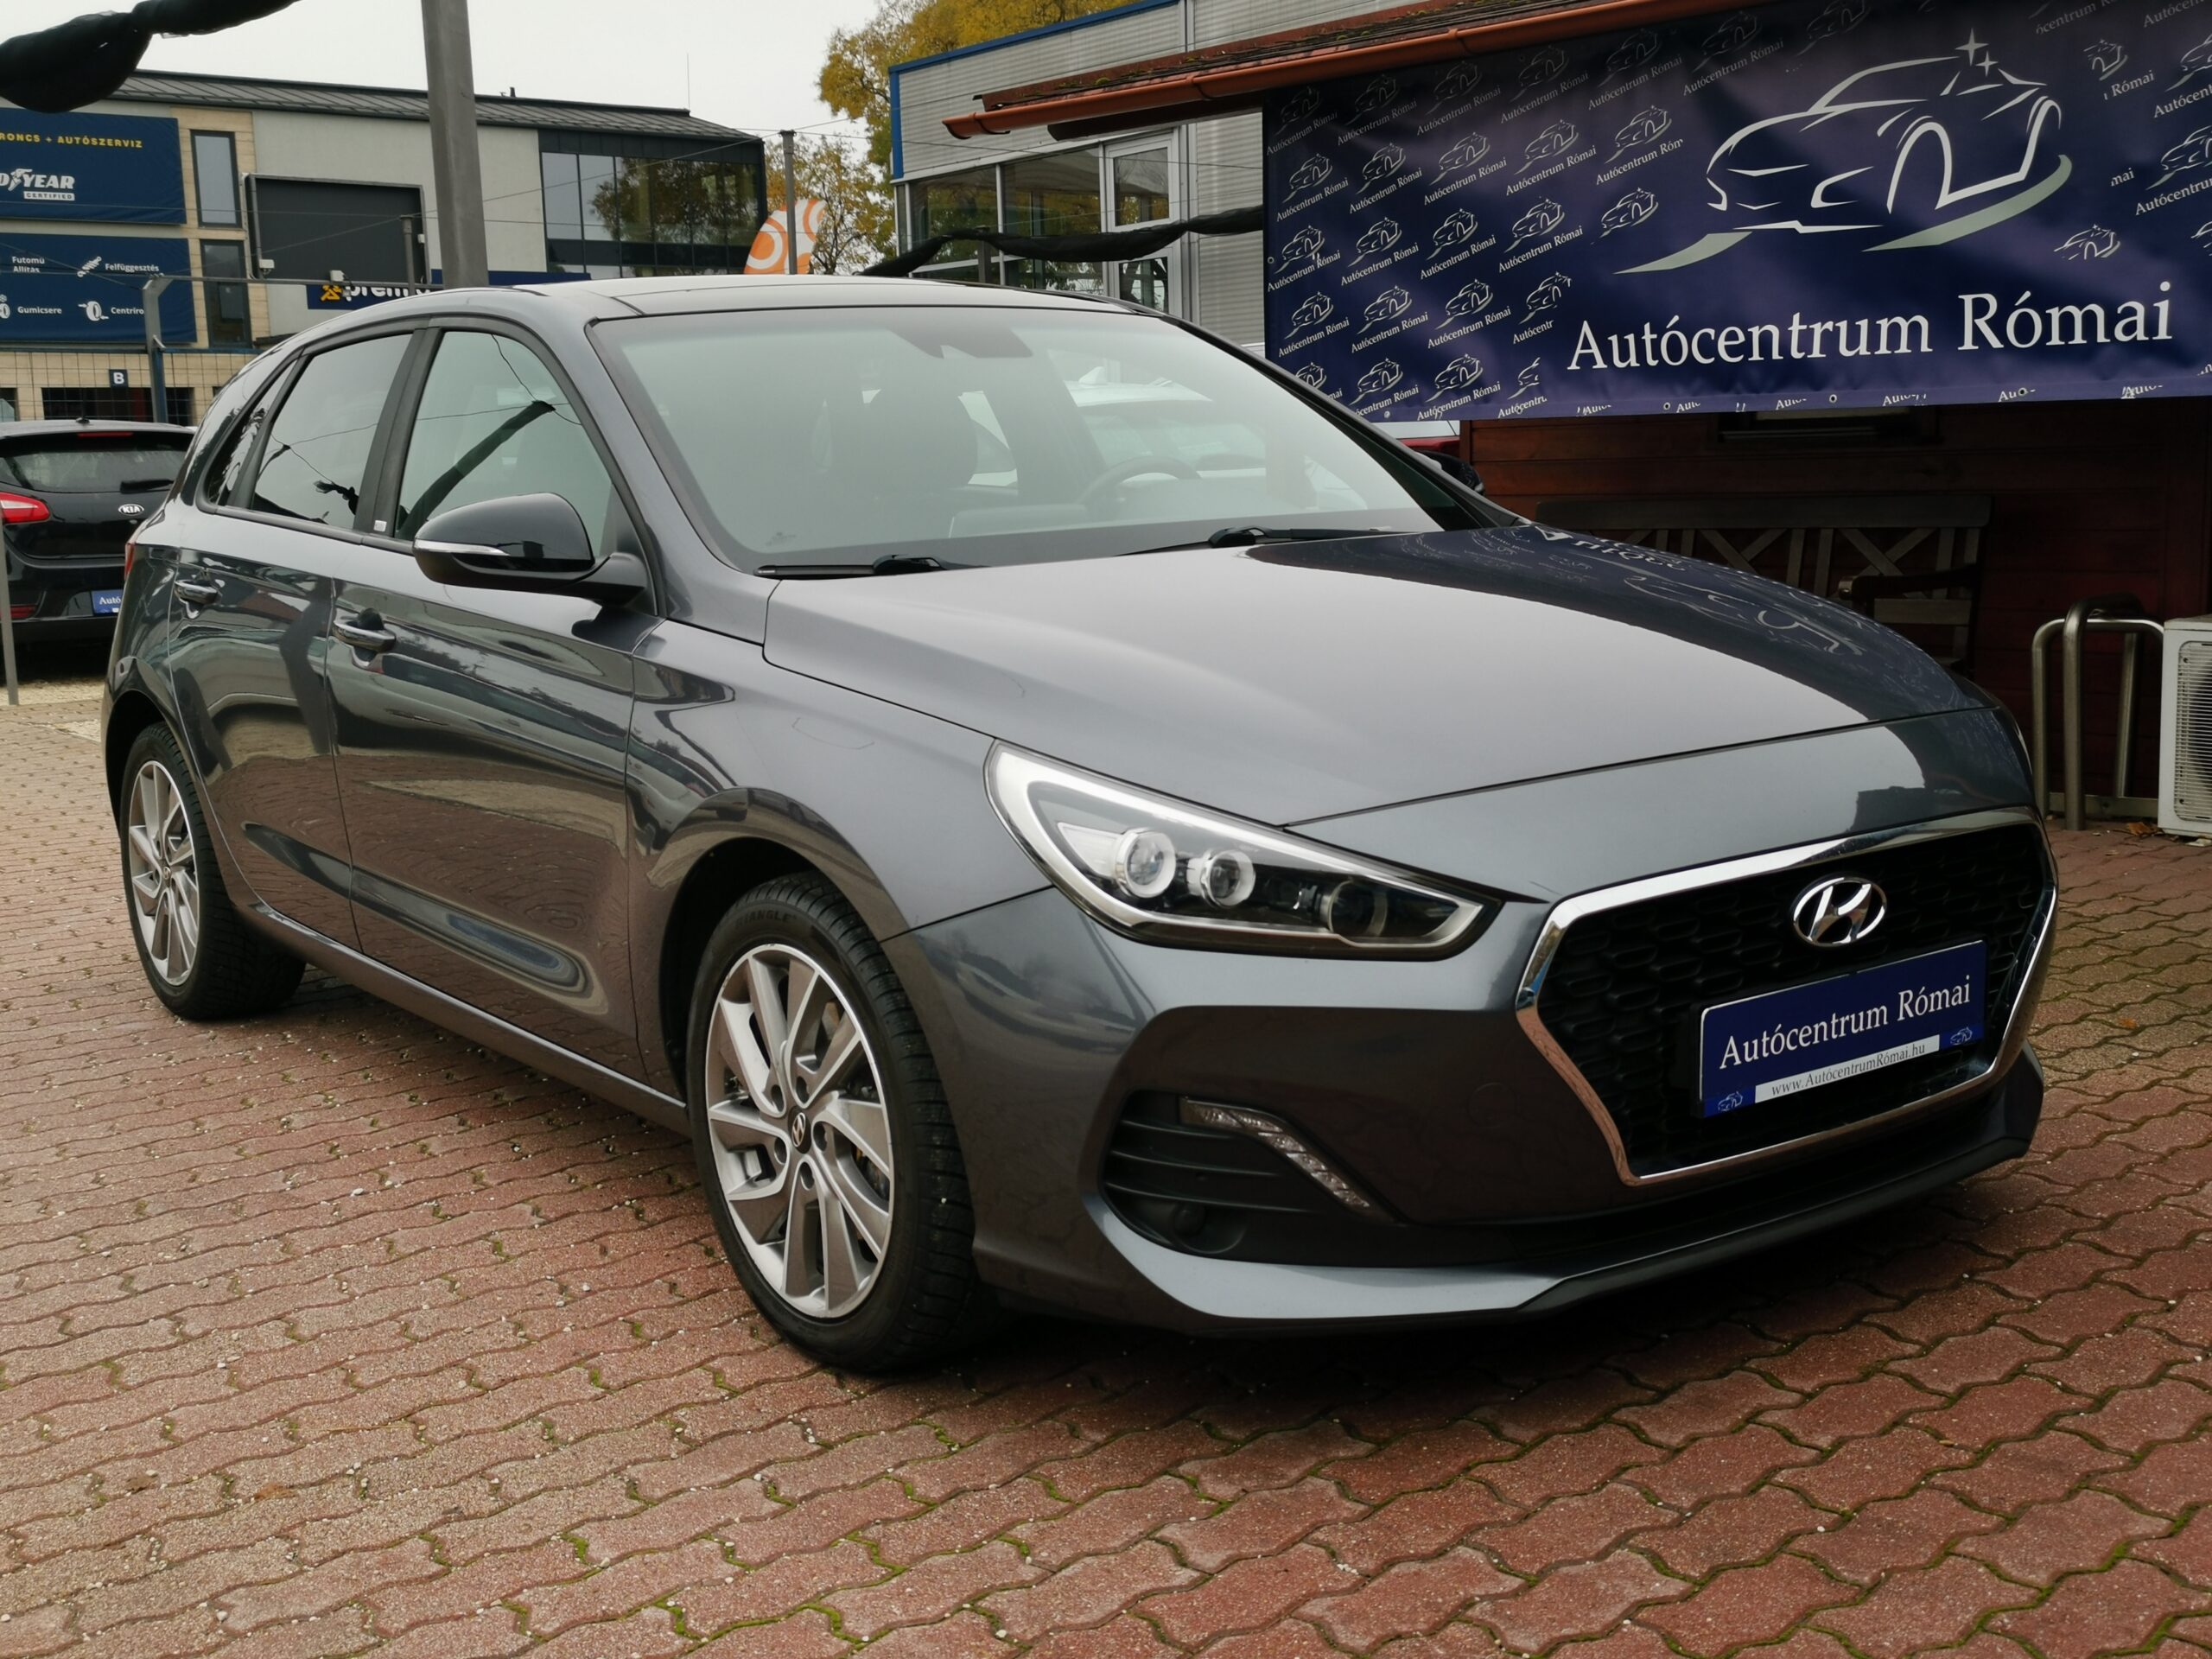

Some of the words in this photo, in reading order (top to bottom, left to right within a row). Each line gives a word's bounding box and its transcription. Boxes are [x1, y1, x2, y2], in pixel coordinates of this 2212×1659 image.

[1588, 72, 1649, 111] Autócentrum
[1650, 55, 1683, 79] Római
[1683, 58, 1748, 96] Autócentrum
[1750, 40, 1784, 64] Római
[1417, 103, 1472, 136] Autócentrum
[1472, 86, 1502, 105] Római
[1501, 88, 1559, 124] Autócentrum
[1560, 73, 1589, 92] Római
[57, 135, 143, 148] AUTÓSZERVIZ
[1338, 114, 1390, 145] Autócentrum
[1390, 98, 1418, 118] Római
[1424, 173, 1477, 206] Autócentrum
[1478, 156, 1507, 178] Római
[1506, 162, 1565, 196] Autócentrum
[1567, 145, 1597, 167] Római
[1596, 148, 1658, 185] Autócentrum
[1276, 192, 1323, 222] Autócentrum
[1324, 177, 1349, 197] Római
[1350, 184, 1397, 213] Autócentrum
[1397, 167, 1423, 188] Római
[105, 263, 160, 273] Felfüggesztés
[1340, 257, 1393, 286] Autócentrum
[1393, 242, 1420, 262] Római
[1420, 250, 1471, 280] Autócentrum
[1471, 234, 1497, 255] Római
[1498, 243, 1553, 273] Autócentrum
[1554, 225, 1584, 247] Római
[1267, 264, 1316, 292] Autócentrum
[17, 306, 62, 315] Gumicsere
[1351, 324, 1400, 353] Autócentrum
[1401, 311, 1429, 331] Római
[1427, 319, 1484, 349] Autócentrum
[1484, 305, 1512, 326] Római
[1567, 311, 1933, 372] Autócentrum
[1958, 281, 2173, 352] Római
[1278, 329, 1325, 358] Autócentrum
[1325, 316, 1350, 334] Római
[113, 372, 125, 385] B
[1393, 385, 1420, 403] Római
[1472, 381, 1501, 399] Római
[122, 505, 141, 514] KIA
[1719, 1005, 1889, 1070] Autócentrum
[1897, 974, 1971, 1022] Római
[1771, 1043, 1926, 1096] www.AutócentrumRómai.hu
